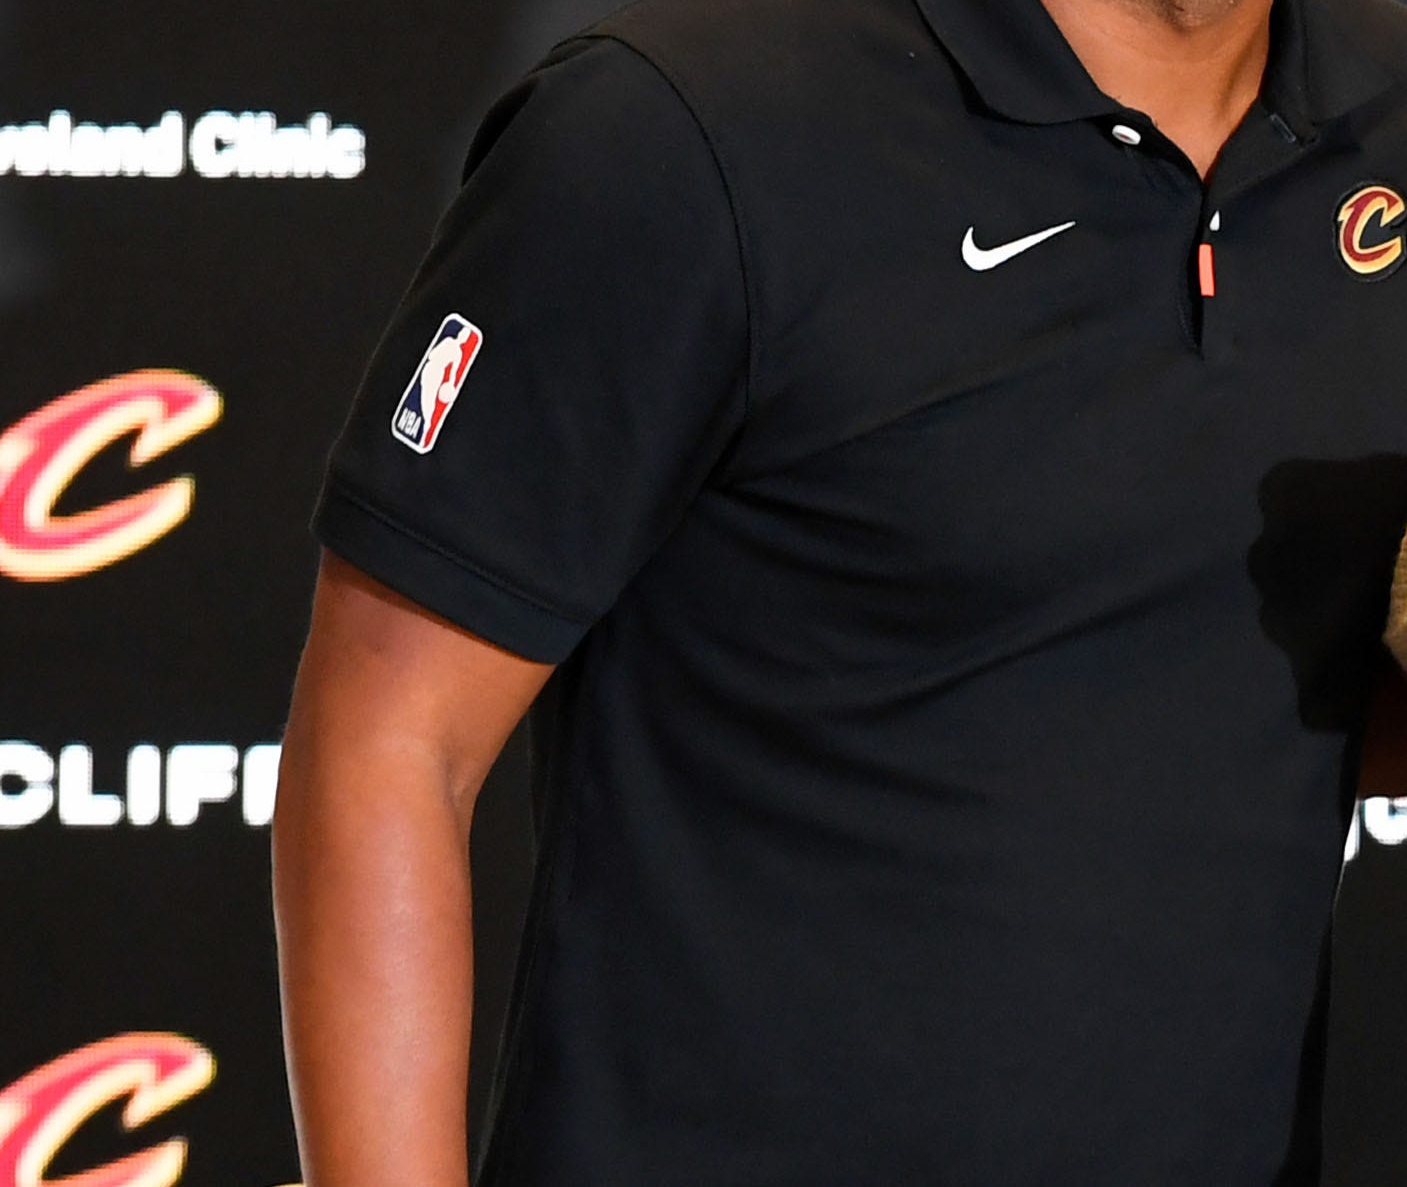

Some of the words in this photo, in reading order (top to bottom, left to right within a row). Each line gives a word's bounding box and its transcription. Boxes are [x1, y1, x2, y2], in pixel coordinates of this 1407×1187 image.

[189, 111, 365, 179] Clinic
[397, 407, 421, 439] NBA
[0, 369, 223, 582] C
